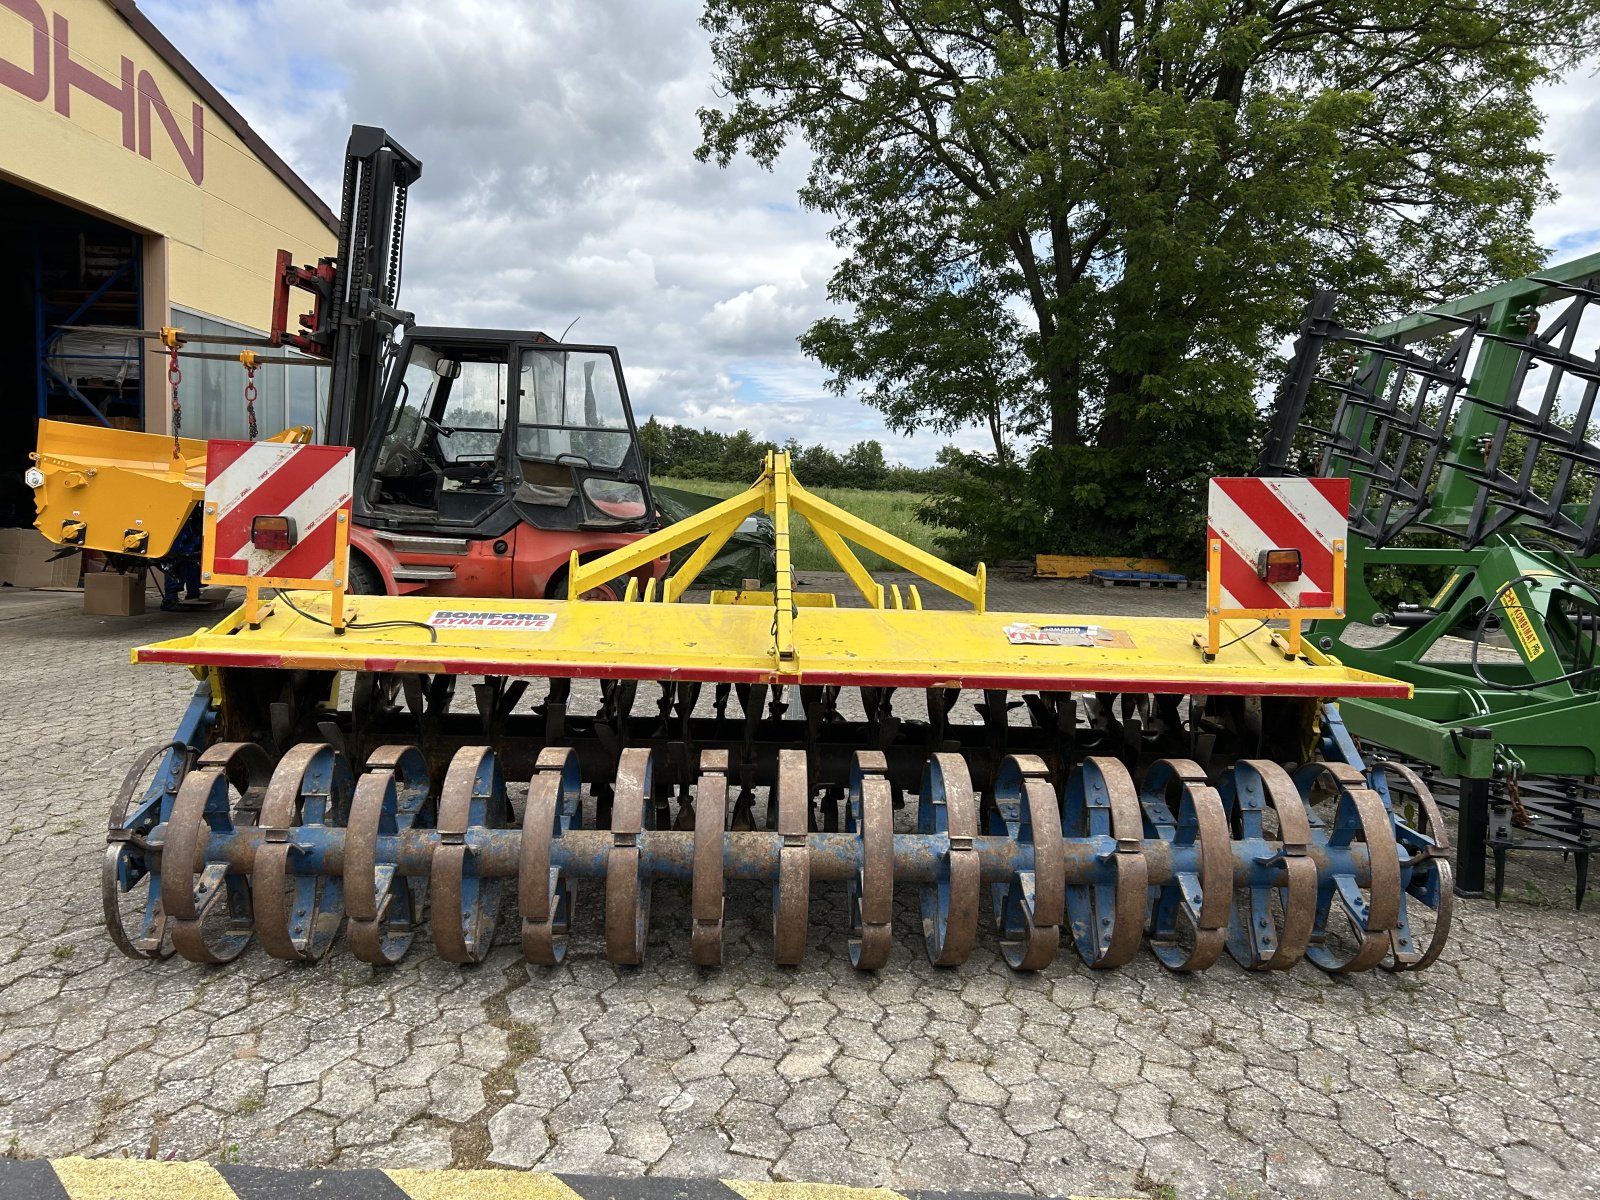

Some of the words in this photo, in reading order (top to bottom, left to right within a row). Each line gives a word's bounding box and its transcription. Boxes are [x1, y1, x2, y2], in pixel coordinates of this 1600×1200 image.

[435, 611, 549, 620] BOMFORD
[432, 618, 484, 626] DYNA
[487, 619, 548, 627] DRIVE
[1514, 608, 1536, 643] KOMBIMAT
